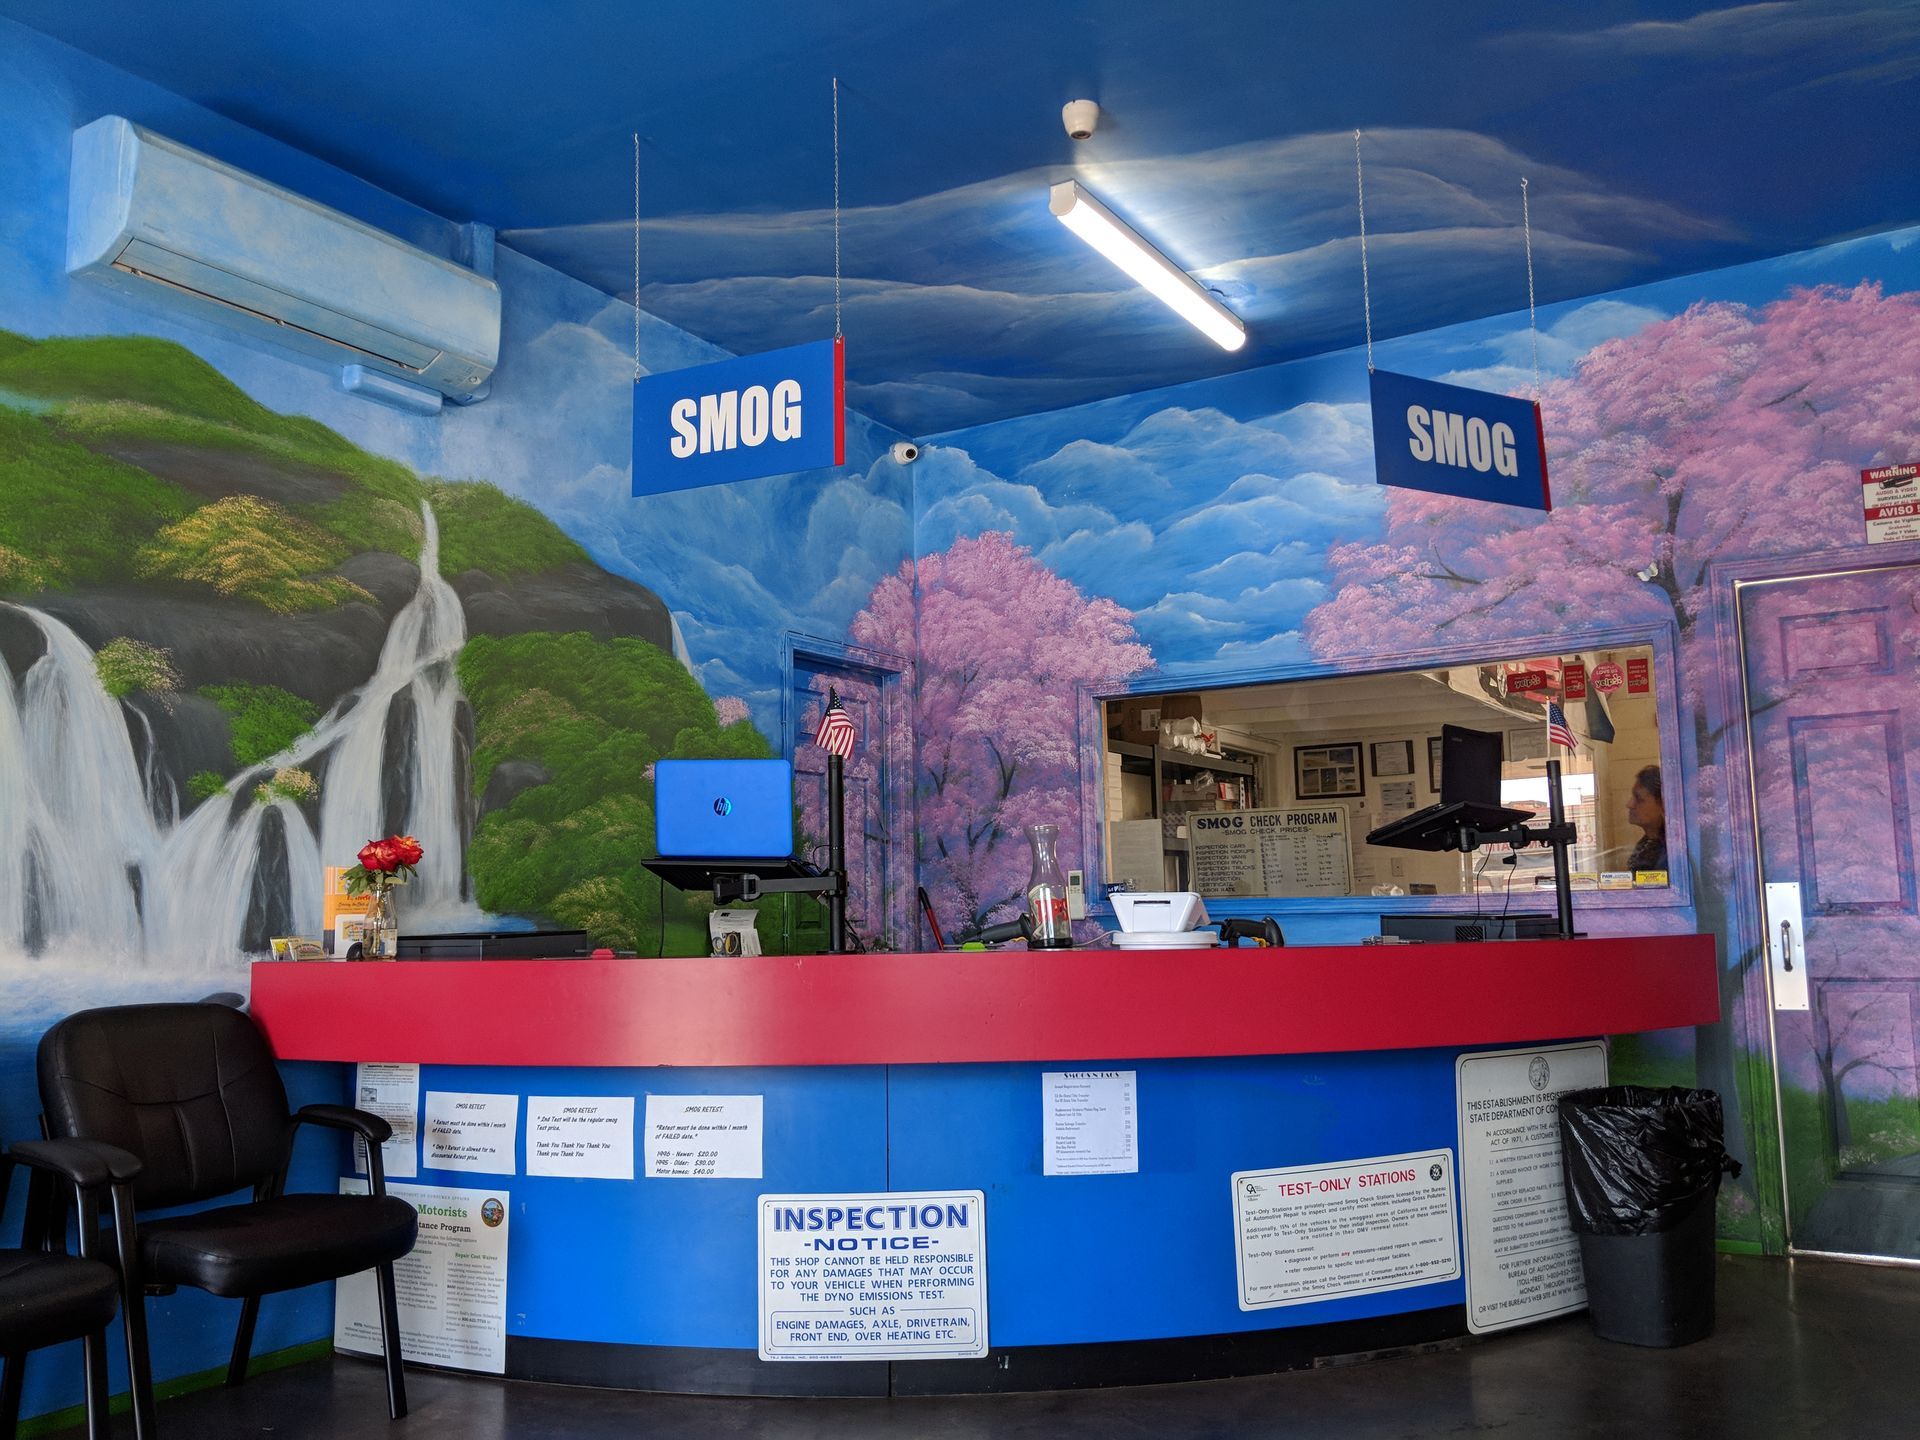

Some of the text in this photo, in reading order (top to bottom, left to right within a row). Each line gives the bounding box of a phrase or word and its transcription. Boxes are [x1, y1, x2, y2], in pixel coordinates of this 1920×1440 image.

[671, 379, 802, 459] SMOG
[1407, 405, 1518, 477] SMOG
[1870, 467, 1917, 479] WARNING
[1877, 493, 1916, 501] SURVEILLANCE
[1879, 506, 1913, 517] AVISO
[715, 797, 731, 816] hp
[1197, 812, 1337, 829] SMOG CHECK PROGRAM
[1467, 1101, 1482, 1111] THIS
[1483, 1095, 1535, 1109] ESTABLISHMENT
[1470, 1112, 1489, 1123] STATE
[1491, 1107, 1534, 1121] DEPARTMENT
[1536, 1106, 1544, 1115] OF
[1278, 1177, 1351, 1196] TEST-ONLY
[1359, 1169, 1416, 1188] STATIONS
[417, 1204, 468, 1218] Motorists
[774, 1203, 968, 1232] INSPECTION
[440, 1223, 471, 1233] Program
[770, 1254, 974, 1266] THIS SHOP CANNOT BE HELD RESPONSIBLE
[770, 1266, 974, 1278] FOR ANY DAMAGES THAT MAY OCCUR
[771, 1278, 975, 1289] TO YOUR VEHICLE WHEN PERFORMING
[800, 1290, 945, 1301] THE DYNO EMISSIONS TEST.
[849, 1306, 895, 1315] SUCH AS
[776, 1317, 970, 1330] ENGINE DAMAGES, AXLE, DRIVETRAIN,
[790, 1330, 956, 1342] FRONT END, OVER HEATING ETC.
